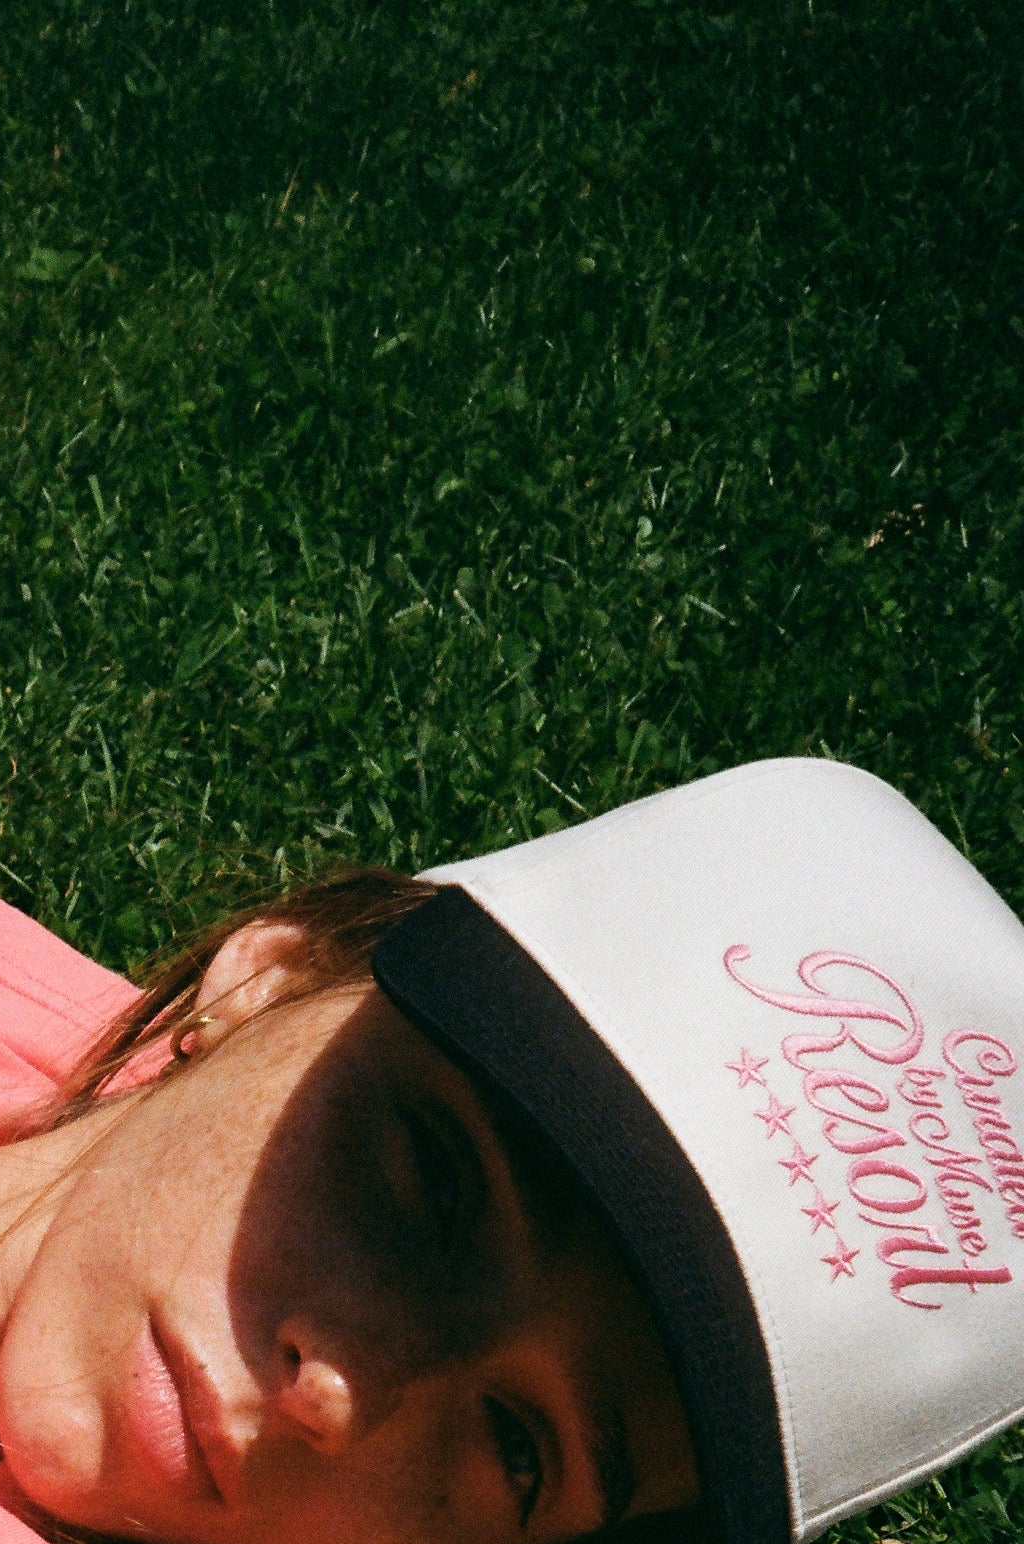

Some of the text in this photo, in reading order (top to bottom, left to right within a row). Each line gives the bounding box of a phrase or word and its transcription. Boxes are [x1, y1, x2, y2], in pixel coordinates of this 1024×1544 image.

[723, 944, 1013, 1310] Resort
[896, 1066, 994, 1257] by Muse
